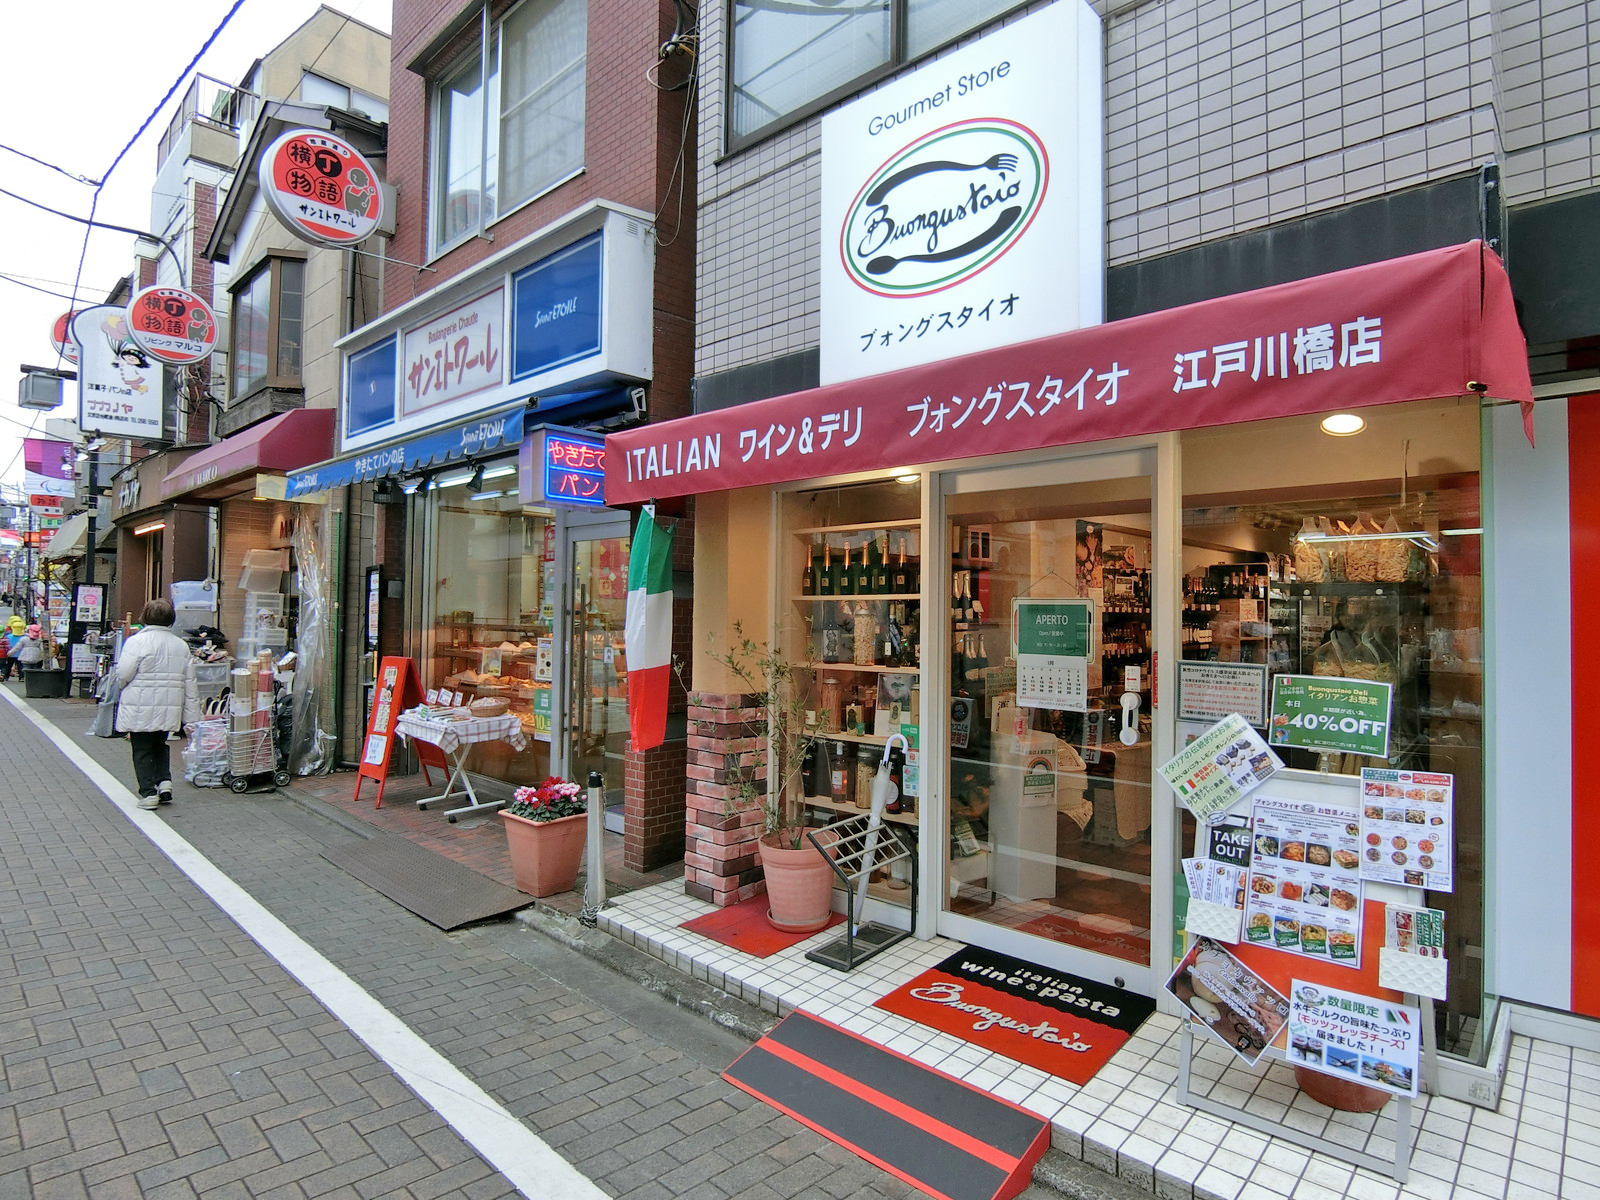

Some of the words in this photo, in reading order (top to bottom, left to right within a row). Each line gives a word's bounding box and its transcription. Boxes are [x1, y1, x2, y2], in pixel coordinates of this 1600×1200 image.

[868, 86, 951, 136] Gourmet
[958, 61, 1011, 97] Store
[291, 170, 339, 202] 物語
[299, 204, 356, 228] サンエトワール
[857, 172, 1021, 259] Buongustaio
[861, 293, 1020, 352] ブォングスタイオ
[408, 322, 498, 399] サンエトワール
[1173, 316, 1382, 394] 江戸川橋店
[906, 361, 1129, 437] ブォングスタイオ
[739, 406, 862, 462] ワイン&デリ
[548, 441, 606, 469] やきたて
[626, 433, 721, 483] ITALIAN
[560, 474, 600, 496] パン
[1035, 614, 1069, 625] APERTO
[1285, 699, 1301, 708] 本日
[1308, 692, 1379, 706] イタリアンお惣菜
[1353, 688, 1369, 696] Deli
[1289, 713, 1385, 737] 40%OFF
[1213, 830, 1250, 847] TAKE
[1216, 844, 1245, 859] OUT
[960, 960, 1023, 986] wine
[1025, 980, 1038, 992] &
[1038, 984, 1121, 1018] pasta
[1013, 968, 1083, 993] italian
[909, 981, 1093, 1053] Buongustaio
[1293, 1002, 1411, 1041] 水牛ミルクの旨味たっぷり
[1327, 995, 1379, 1018] 数量限定
